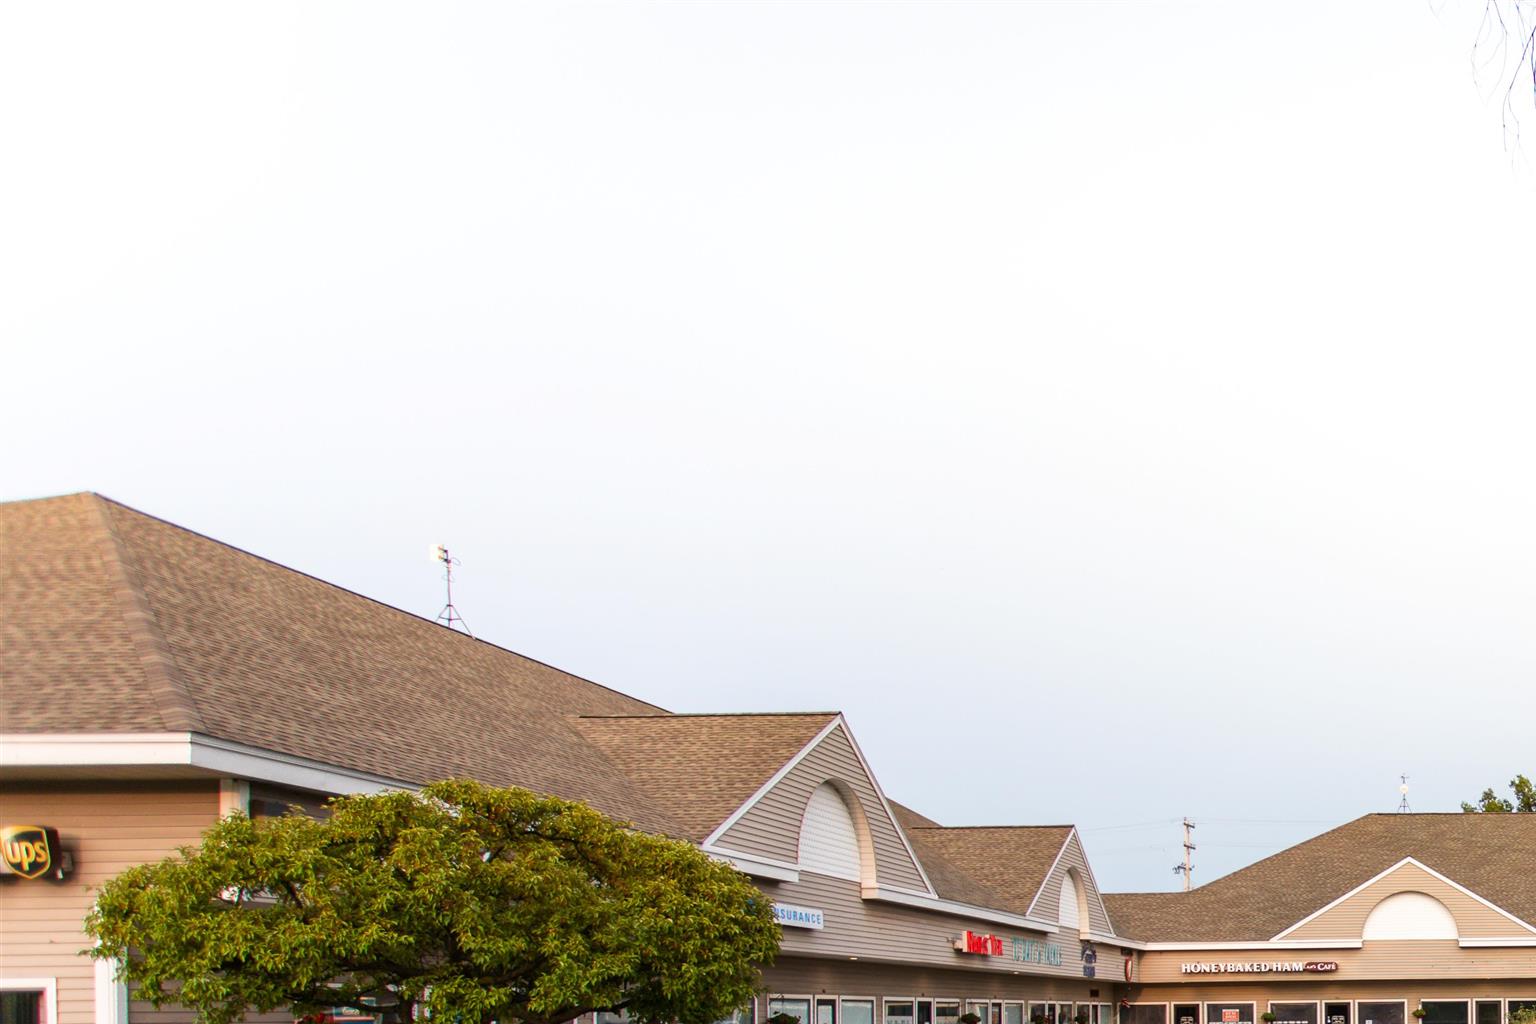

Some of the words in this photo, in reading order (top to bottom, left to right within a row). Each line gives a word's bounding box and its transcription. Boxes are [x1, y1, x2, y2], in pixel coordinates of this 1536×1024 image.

[4, 839, 47, 871] ups
[773, 906, 821, 924] NSURANCE
[1181, 962, 1270, 974] HONEYBAKED
[1273, 962, 1304, 972] HAM
